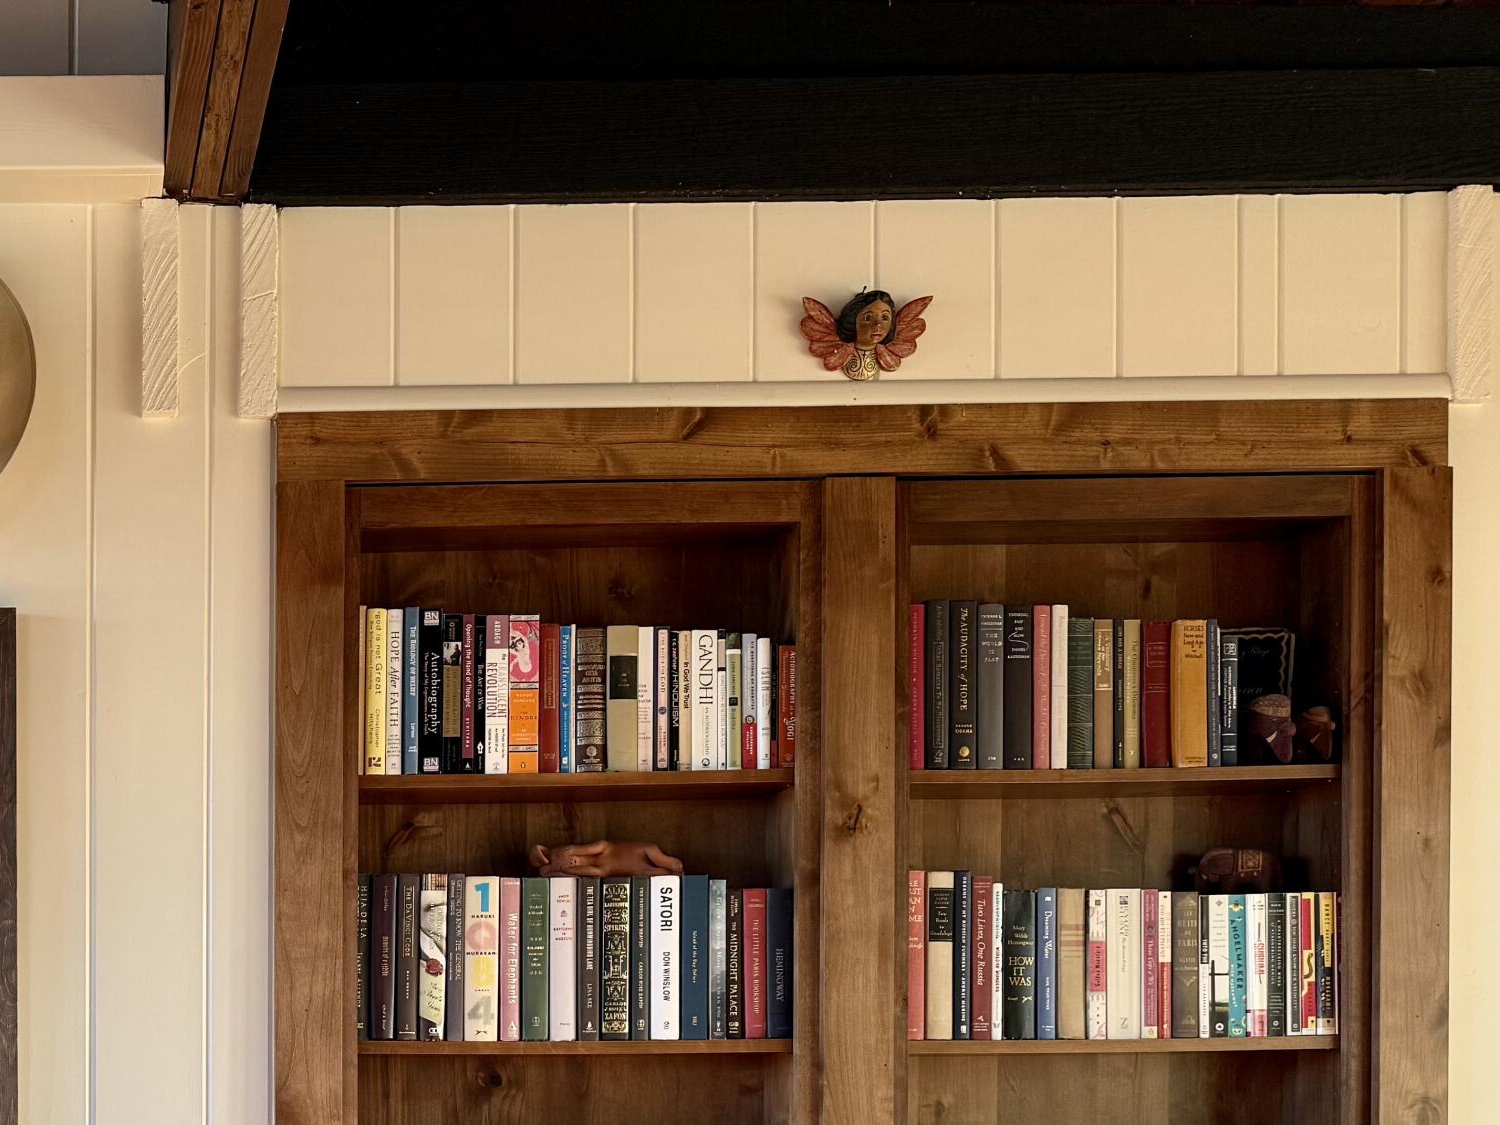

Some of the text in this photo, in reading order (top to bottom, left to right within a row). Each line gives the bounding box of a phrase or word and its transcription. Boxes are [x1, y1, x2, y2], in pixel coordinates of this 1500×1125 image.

[390, 631, 399, 662] HOPE
[464, 624, 472, 648] Opening
[389, 667, 400, 688] After
[699, 634, 713, 705] GANDHI
[428, 652, 440, 734] Autobiography
[486, 662, 497, 718] REVOLUTION
[684, 683, 689, 693] We
[390, 692, 399, 727] FAITH
[660, 887, 672, 931] SATORI
[977, 899, 986, 916] Two
[507, 913, 518, 1004] Water for Elephants
[729, 934, 737, 981] MIDNIGHT
[977, 942, 985, 959] One
[1009, 956, 1034, 966] HOW
[1229, 919, 1243, 989] ANGELMAKER
[977, 962, 986, 986] Russia
[1010, 977, 1031, 986] WAS
[1014, 967, 1025, 976] IT
[729, 984, 737, 1016] PALACE
